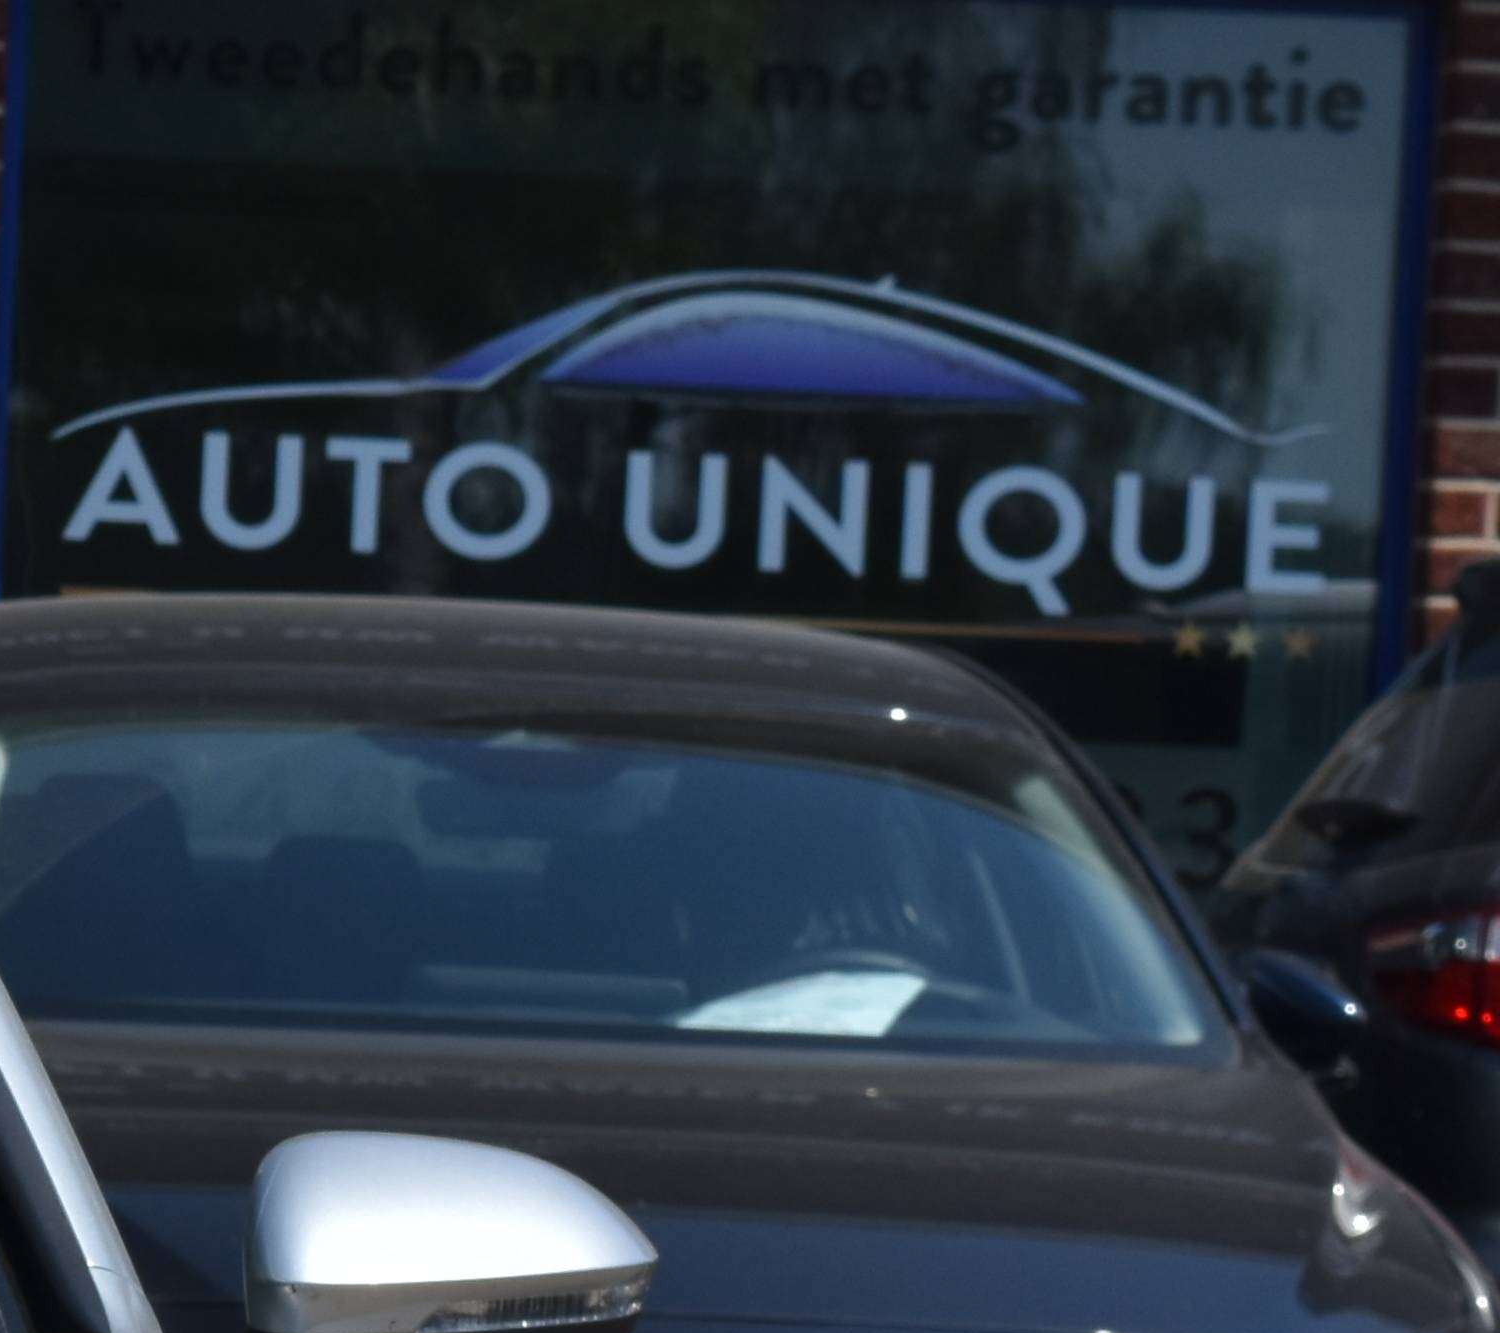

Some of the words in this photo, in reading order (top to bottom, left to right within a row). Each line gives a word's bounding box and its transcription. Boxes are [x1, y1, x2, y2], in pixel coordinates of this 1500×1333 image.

[68, 0, 712, 108] Tweedehands
[756, 52, 932, 115] met
[970, 46, 1367, 152] garantie
[61, 427, 551, 561] AUTO
[623, 448, 1330, 618] UNIQUE
